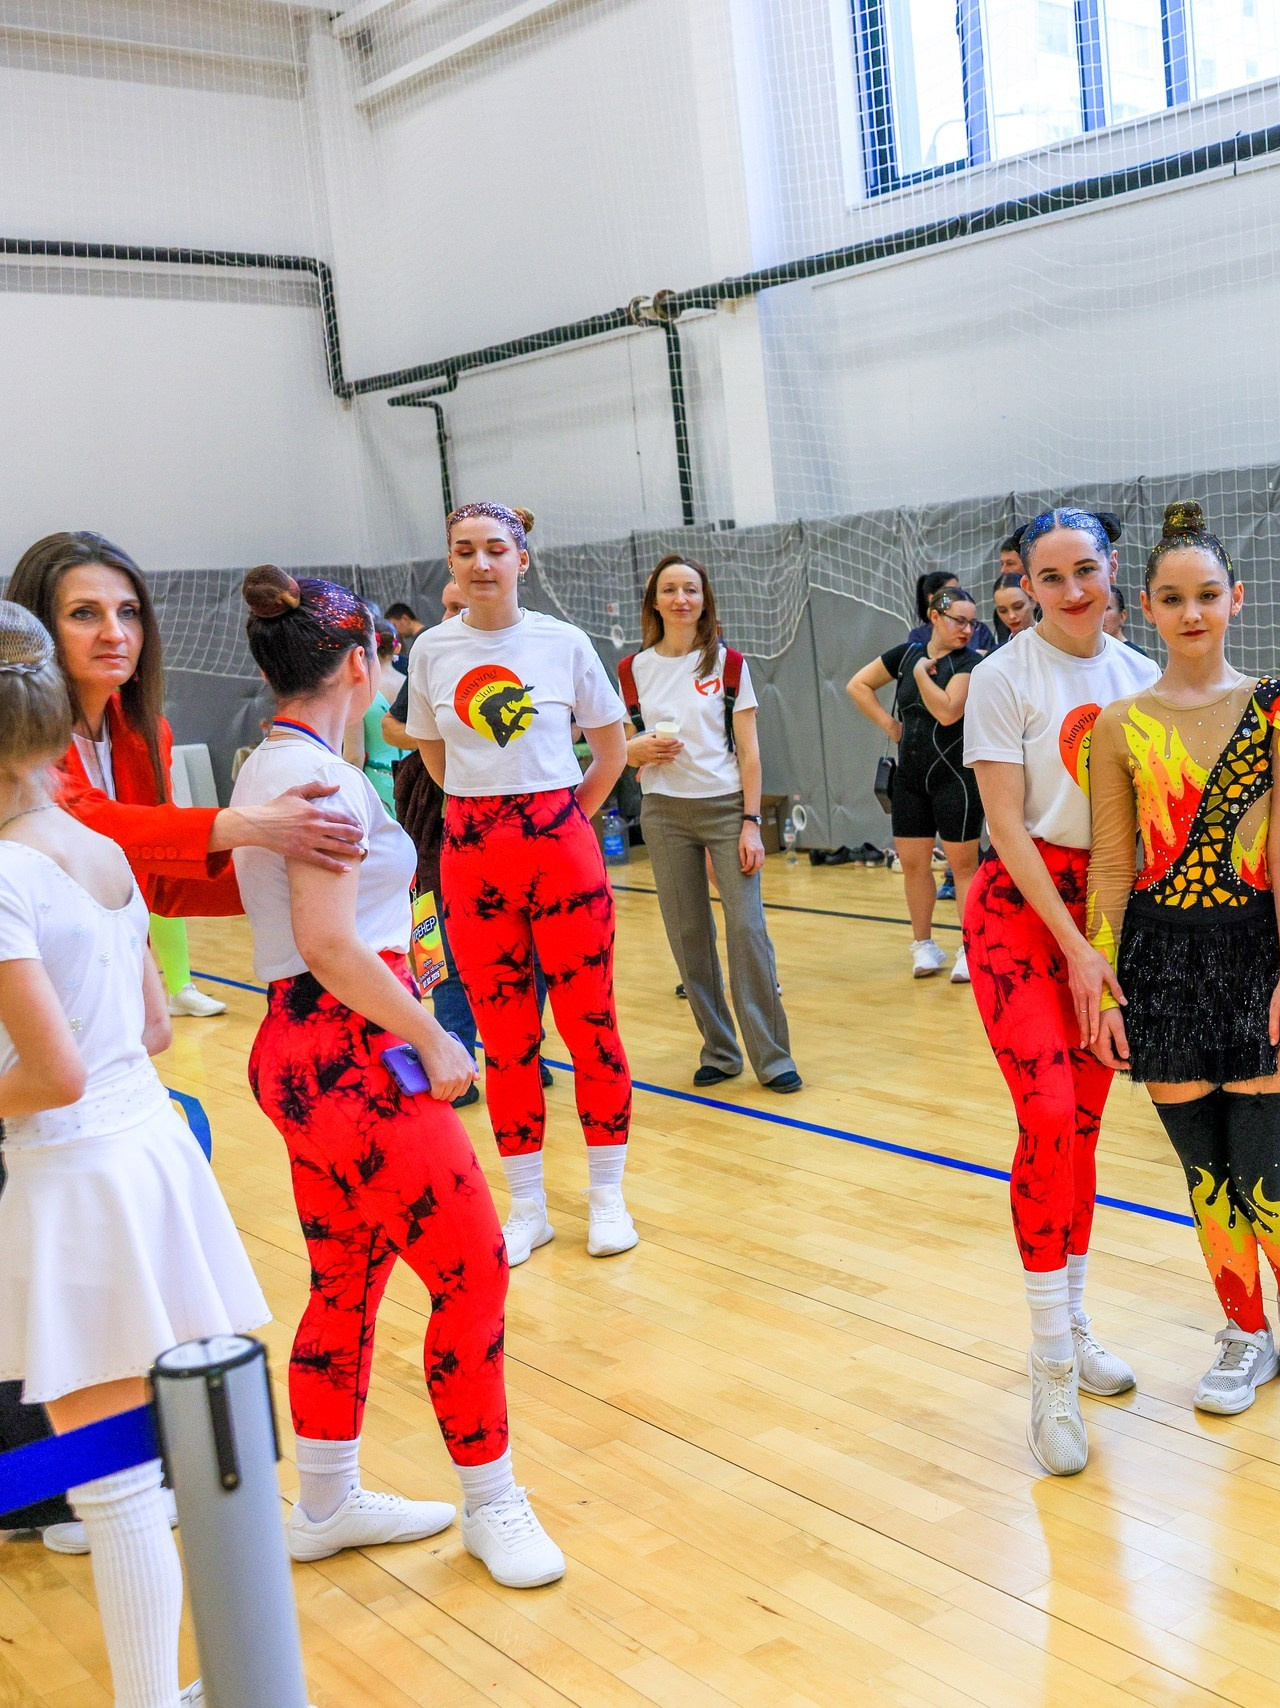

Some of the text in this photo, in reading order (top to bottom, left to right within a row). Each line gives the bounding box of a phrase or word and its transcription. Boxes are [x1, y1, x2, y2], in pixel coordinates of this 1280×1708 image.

[457, 669, 497, 704] Jumping
[475, 685, 495, 702] Club
[1063, 711, 1097, 749] Jumpin
